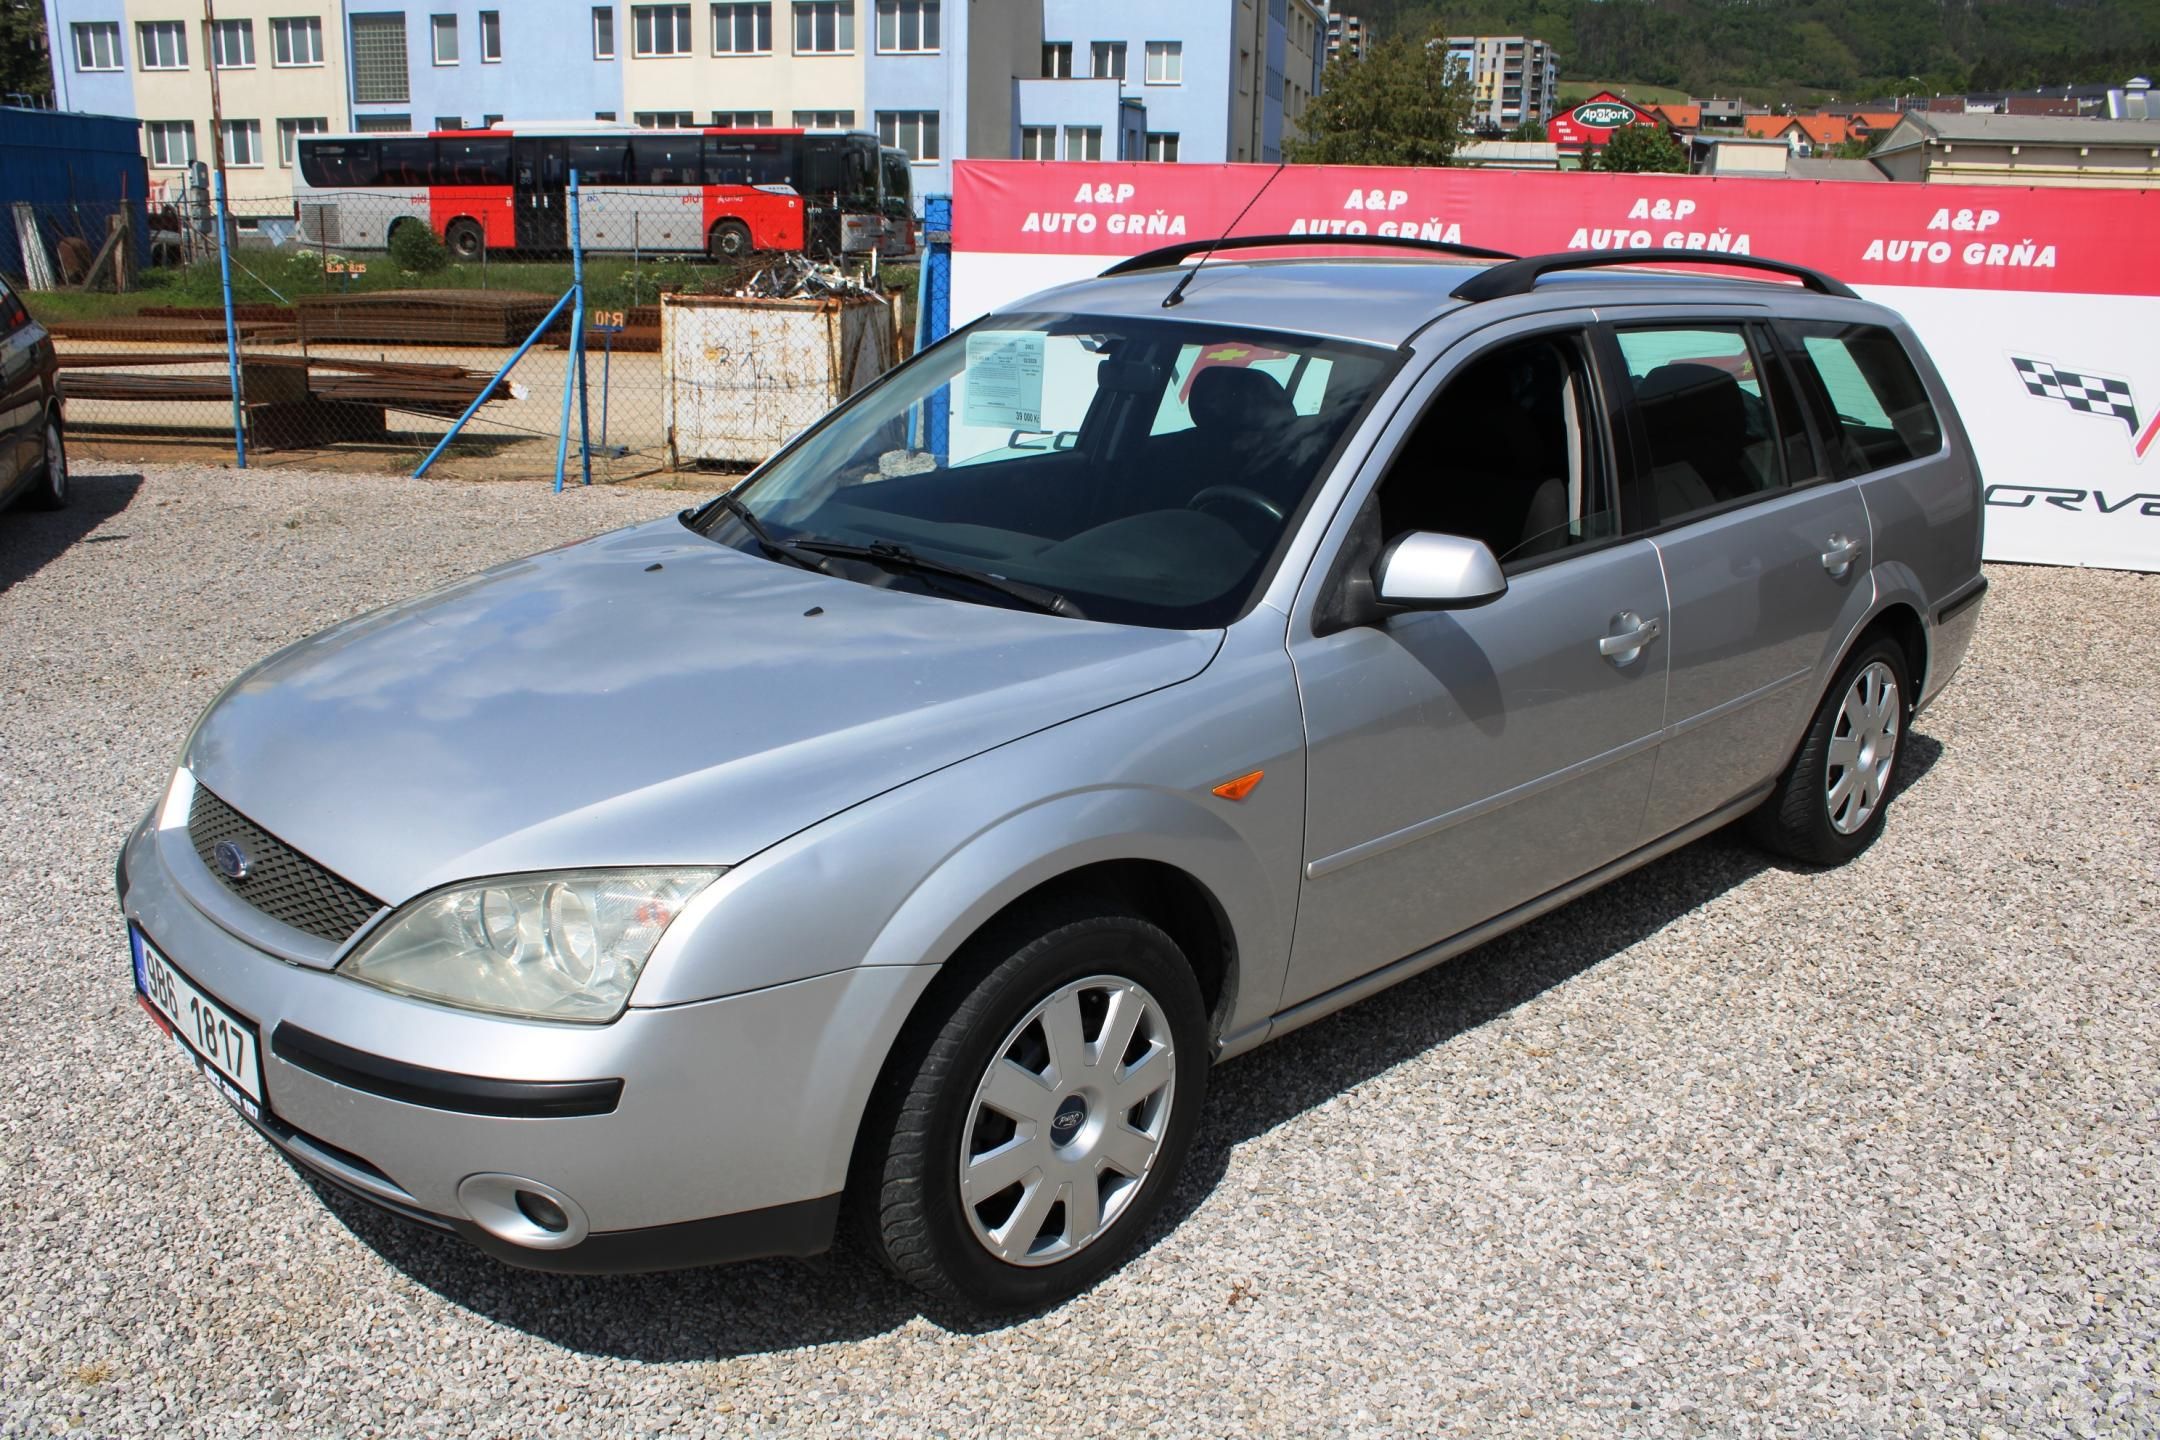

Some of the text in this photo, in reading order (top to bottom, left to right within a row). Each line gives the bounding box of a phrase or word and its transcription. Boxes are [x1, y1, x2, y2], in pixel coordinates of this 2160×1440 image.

[1074, 183, 1135, 203] A&P
[1344, 189, 1408, 210] A&P
[1021, 209, 1187, 235] AUTO GRŇA
[1628, 198, 1696, 220] A&P
[1927, 208, 2000, 231] A&P
[1288, 217, 1461, 244] AUTO GRŇA
[1567, 227, 1750, 256] AUTO GRŇA
[1862, 238, 2056, 267] AUTO GRŇA
[145, 950, 179, 1020] 9B6
[190, 996, 244, 1078] 1817
